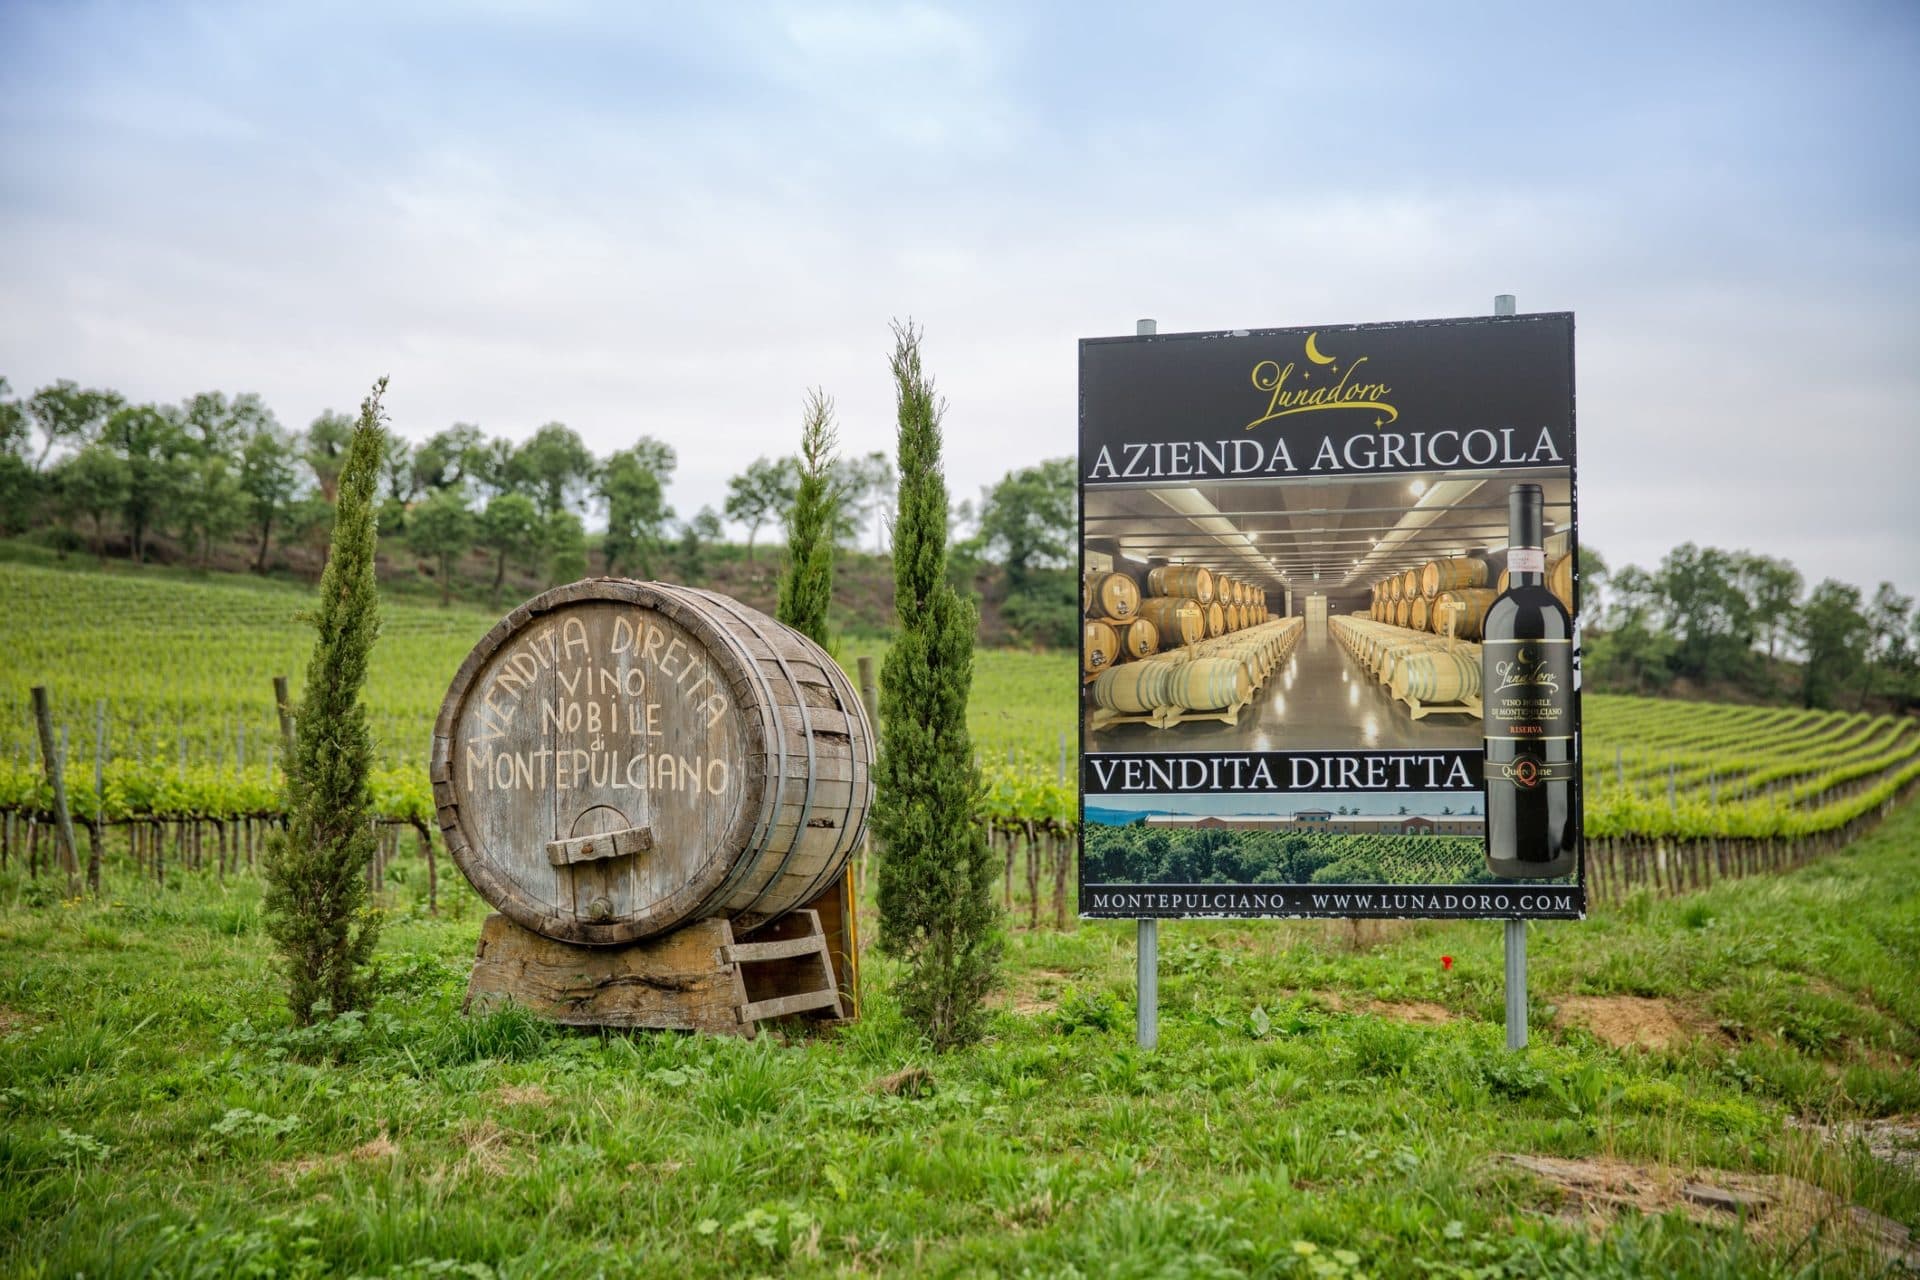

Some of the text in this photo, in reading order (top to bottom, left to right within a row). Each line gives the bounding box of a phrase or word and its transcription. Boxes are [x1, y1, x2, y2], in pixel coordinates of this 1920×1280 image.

[1246, 356, 1399, 431] Lunadoro
[1088, 426, 1564, 479] AZIENDA AGRICOLA
[590, 734, 605, 751] di
[1509, 725, 1544, 734] RISERVA
[1090, 754, 1475, 791] VENDITA DIRETTA
[1092, 893, 1286, 910] MONTEPULCIANO
[1311, 893, 1573, 911] WWW.LUNADORO.COM
